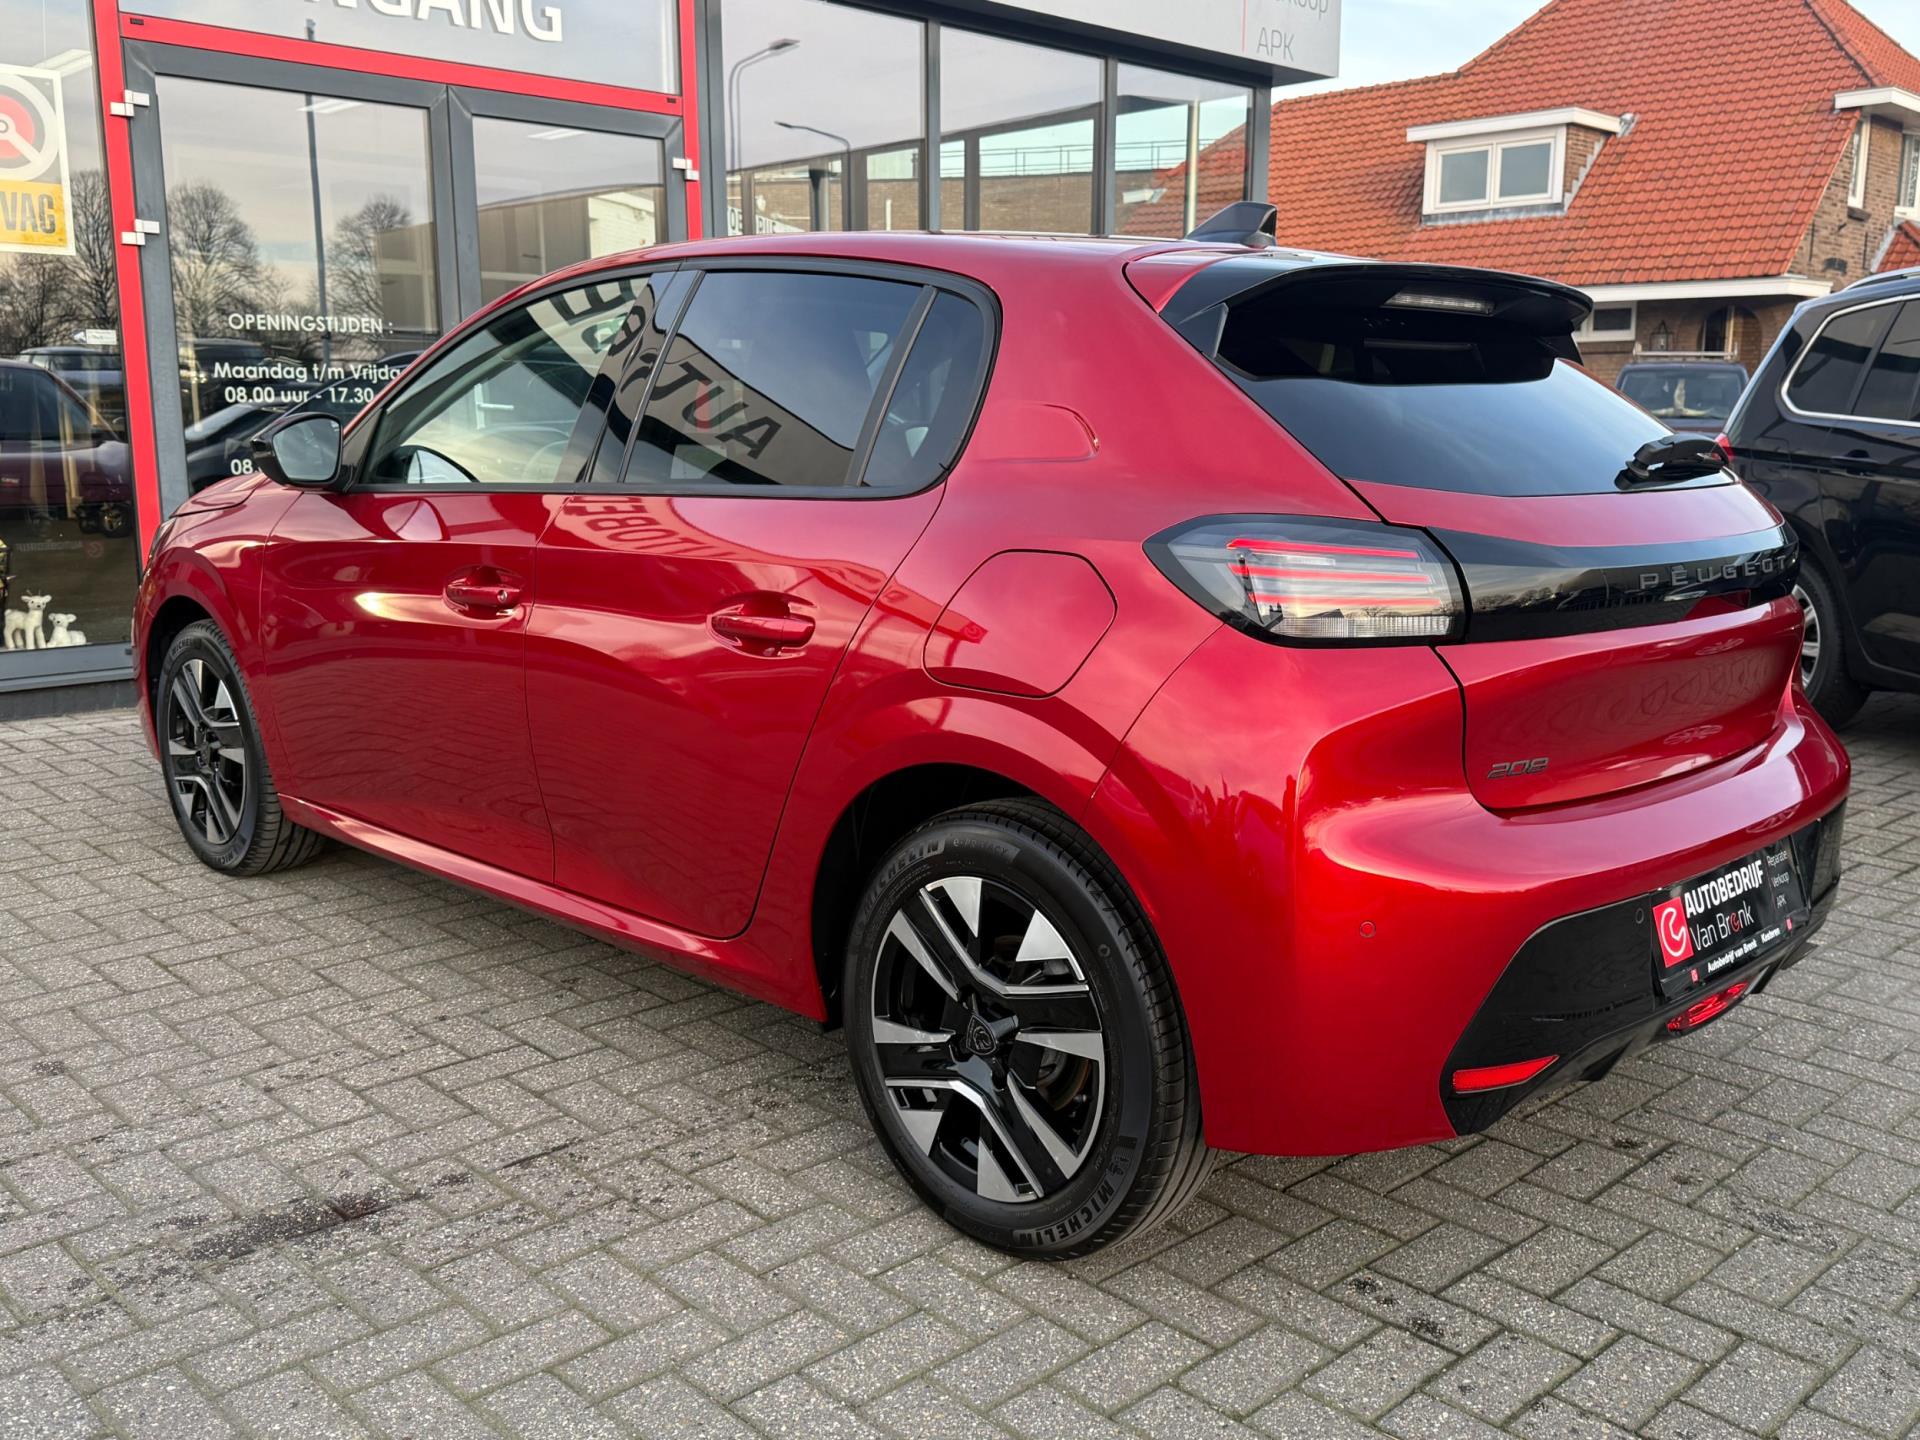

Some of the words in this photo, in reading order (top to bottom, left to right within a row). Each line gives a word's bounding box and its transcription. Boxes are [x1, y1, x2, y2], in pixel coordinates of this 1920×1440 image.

[1256, 26, 1295, 61] APK
[228, 313, 383, 334] OPENINGSTIJDEN
[214, 362, 308, 383] Maandag
[312, 363, 345, 382] t/m
[350, 364, 401, 384] Vrijda
[224, 386, 275, 403] 08.00
[280, 389, 310, 403] uur
[329, 387, 374, 403] 17.30
[231, 458, 263, 475] 08.
[1639, 555, 1787, 590] PEUGEOT
[1488, 757, 1550, 779] 208
[1684, 859, 1764, 919] AUTOBEDRIJF
[1690, 924, 1718, 951] Van
[1019, 1179, 1115, 1247] MICHELIN
